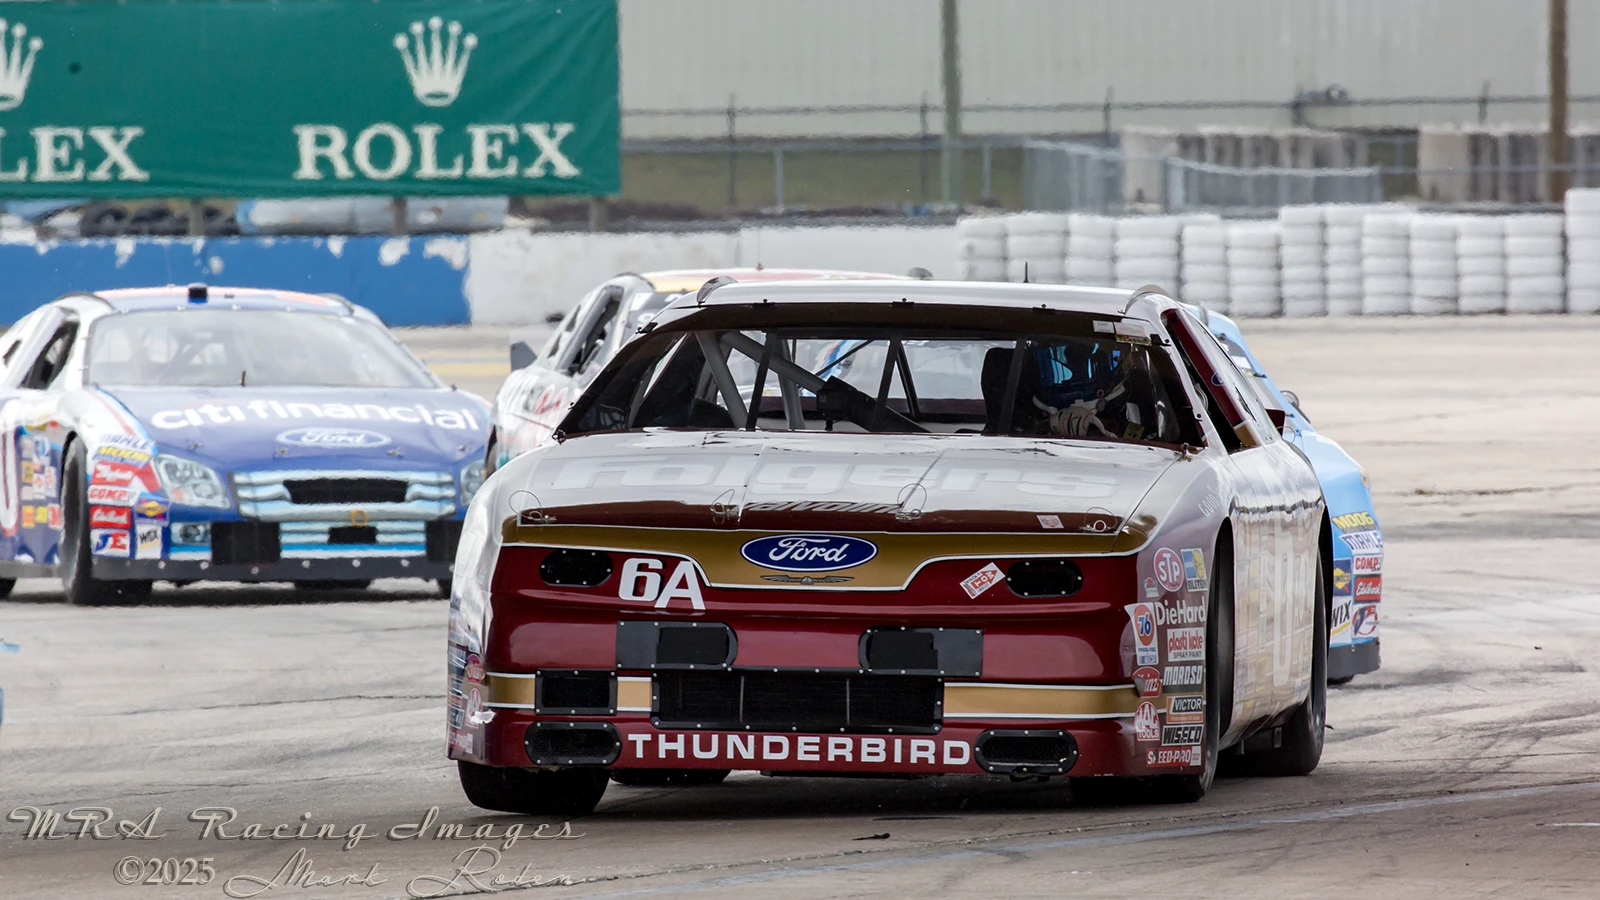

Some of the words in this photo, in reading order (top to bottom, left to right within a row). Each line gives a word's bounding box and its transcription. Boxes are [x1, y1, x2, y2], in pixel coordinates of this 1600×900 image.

[293, 122, 580, 180] ROLEX
[301, 430, 366, 448] Ford
[1331, 511, 1375, 528] MOOG
[95, 532, 127, 553] JE
[769, 537, 850, 562] Ford
[1341, 532, 1383, 550] MAHLE
[1158, 553, 1180, 584] STP
[1355, 557, 1379, 570] COMP
[618, 557, 706, 610] 6A
[1155, 597, 1206, 625] DieHard
[1137, 612, 1151, 636] 76
[1163, 665, 1203, 686] MOROSO
[1174, 699, 1202, 711] VICTOR
[1135, 703, 1159, 729] MAC
[1137, 729, 1159, 739] TOOLS
[1163, 726, 1203, 745] WISECO
[628, 734, 971, 766] THUNDERBIRD
